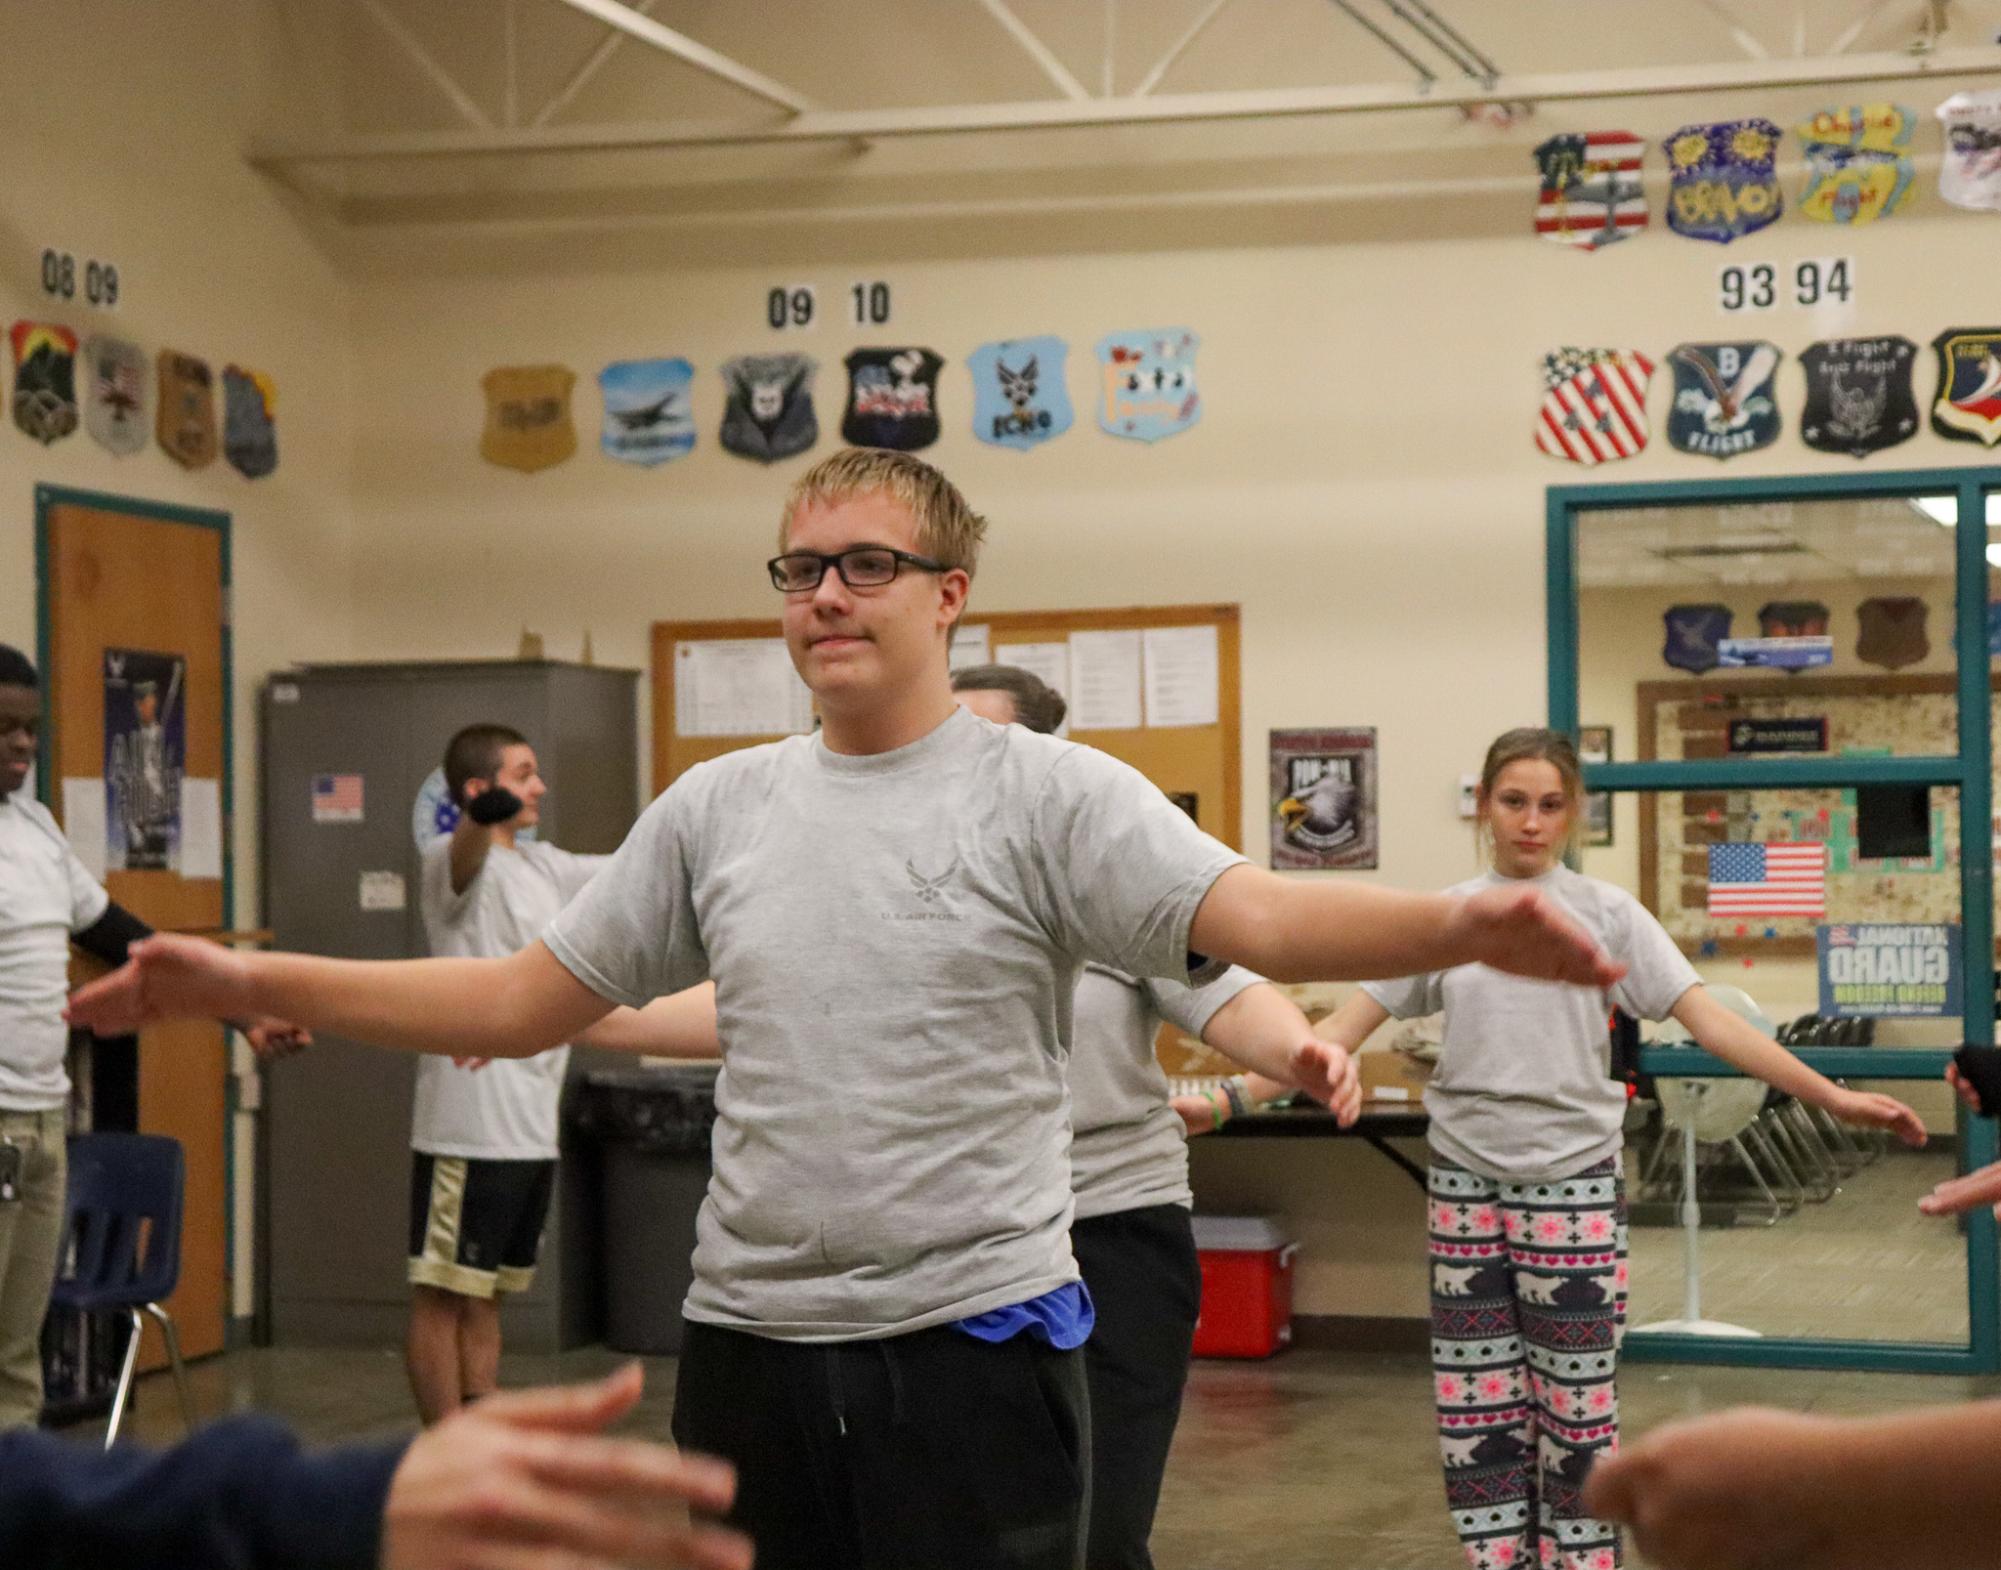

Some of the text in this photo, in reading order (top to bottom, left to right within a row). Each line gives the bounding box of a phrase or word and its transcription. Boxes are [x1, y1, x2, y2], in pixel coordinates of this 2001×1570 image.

[42, 248, 119, 305] 08 09
[1721, 258, 1852, 310] 93 94
[768, 281, 890, 329] 09 10
[1717, 346, 1741, 379] B
[1687, 429, 1756, 455] FLIGHT
